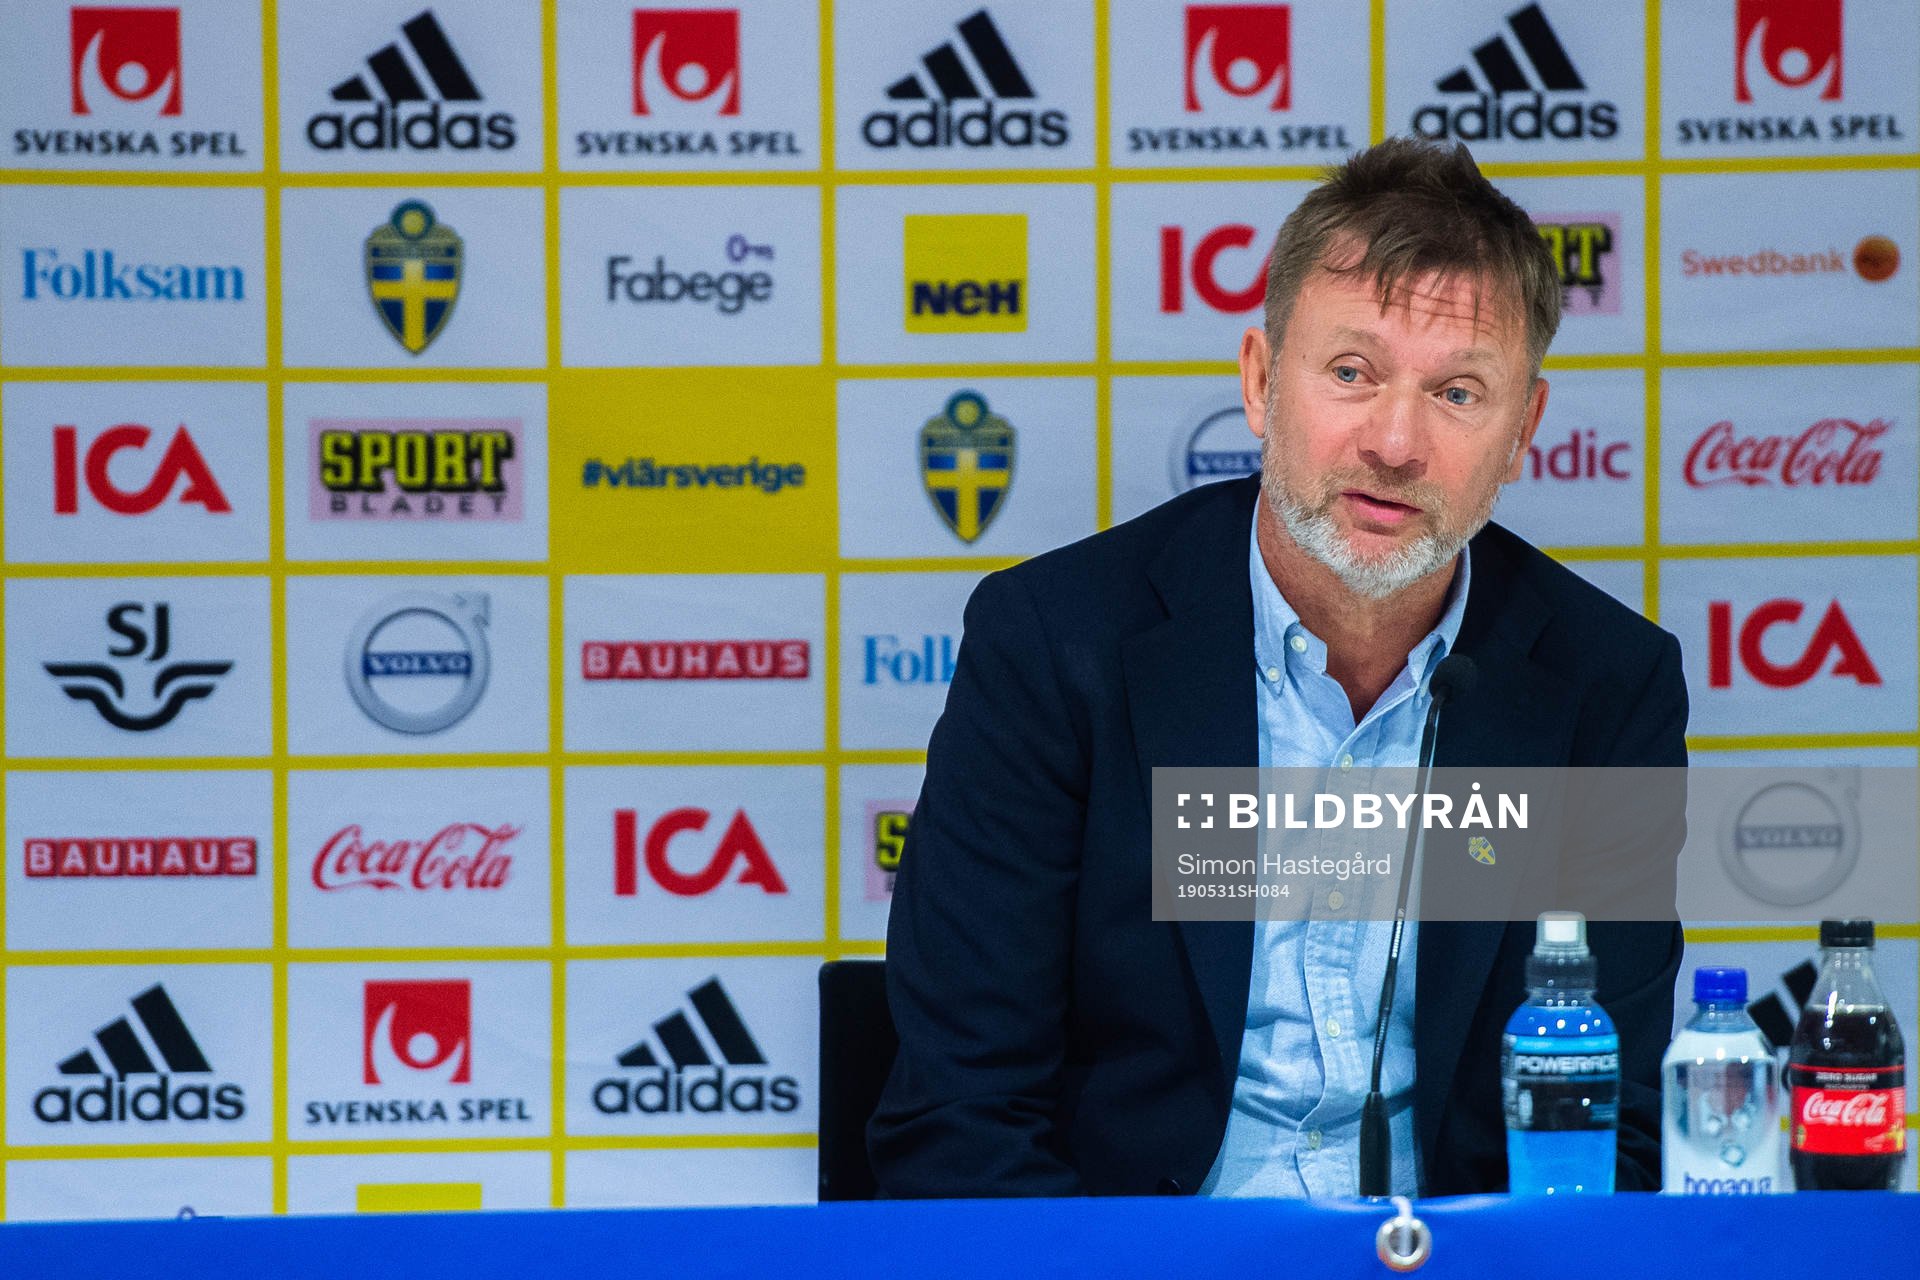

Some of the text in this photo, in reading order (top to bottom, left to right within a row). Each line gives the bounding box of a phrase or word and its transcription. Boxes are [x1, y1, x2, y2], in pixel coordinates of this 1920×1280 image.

[306, 99, 518, 152] adidas
[861, 98, 1070, 149] adidas
[1128, 126, 1350, 152] SVENSKA SPEL
[1413, 92, 1619, 141] adidas
[1678, 115, 1902, 143] SVENSKA SPEL
[14, 130, 245, 157] SVENSKA SPEL
[576, 131, 801, 156] SVENSKA SPEL
[22, 248, 245, 301] Folksam
[606, 255, 774, 314] Fabege
[1160, 224, 1277, 314] IC
[1681, 249, 1846, 277] Swedbank
[53, 424, 232, 515] ICA
[320, 429, 515, 493] SPORT
[1527, 427, 1632, 480] ndic
[330, 493, 508, 516] BLADET
[106, 602, 170, 662] SJ
[1708, 599, 1882, 690] ICA
[368, 654, 468, 672] VOLVO
[583, 642, 809, 678] BAUHAUS
[863, 634, 957, 686] Folk
[26, 839, 257, 876] BAUHAUS
[614, 807, 789, 897] ICA
[32, 1073, 247, 1124] adidas
[306, 1098, 531, 1124] SVENSKA SPEL
[592, 1066, 800, 1117] adidas
